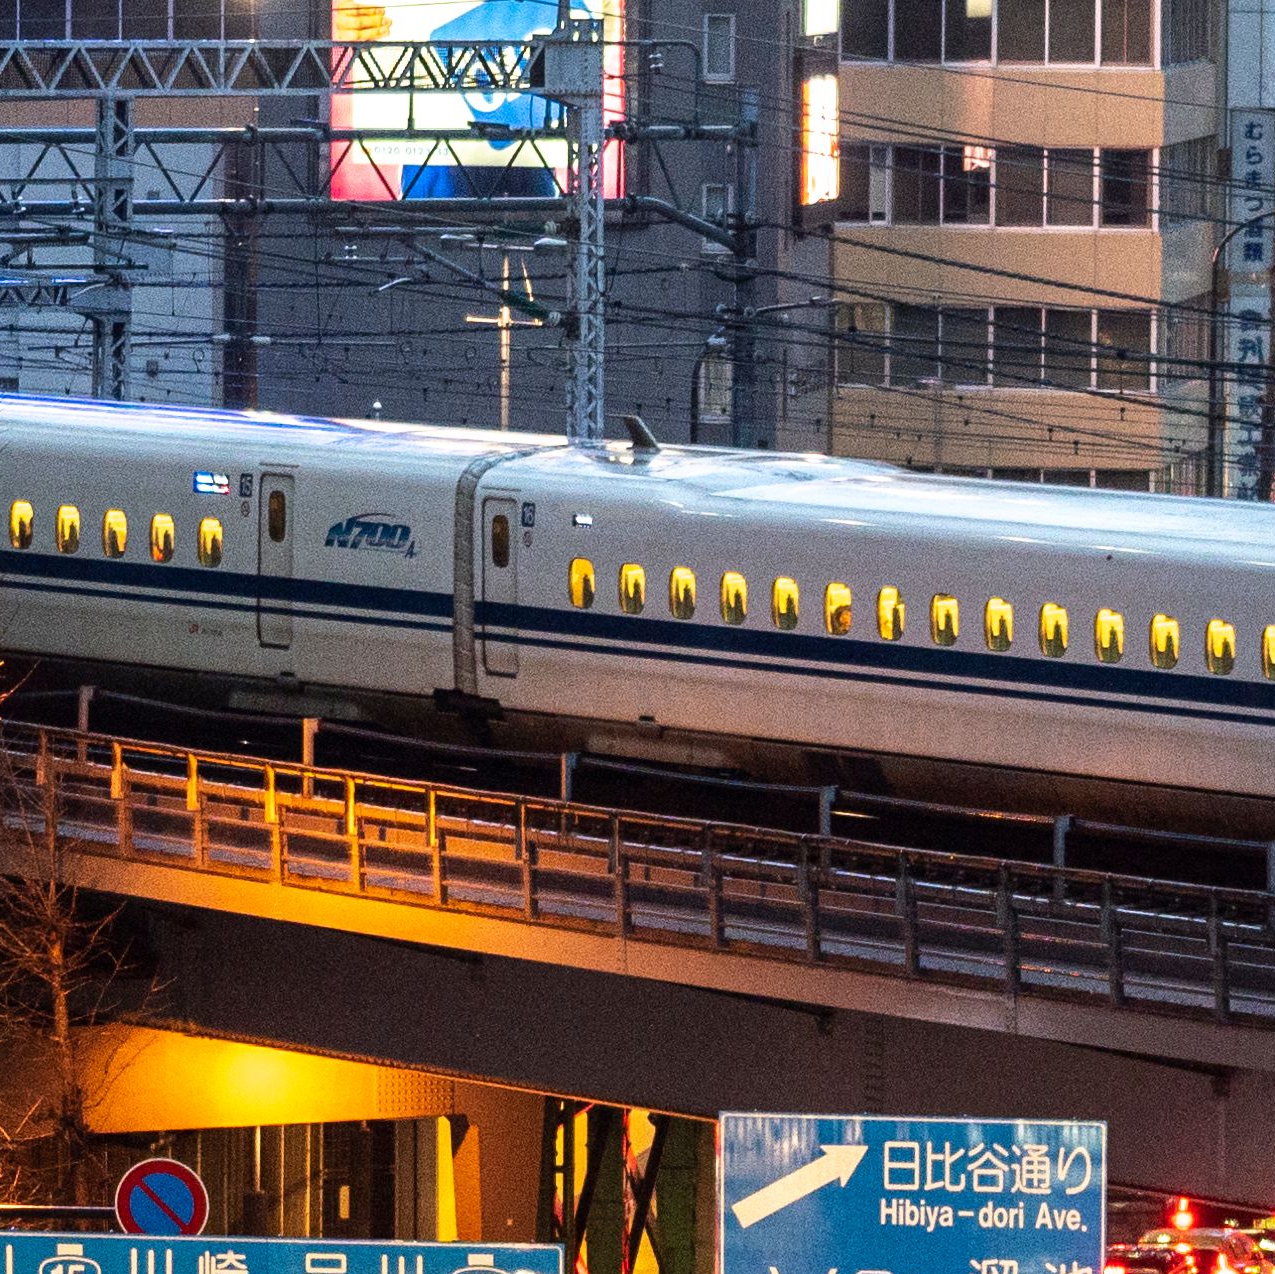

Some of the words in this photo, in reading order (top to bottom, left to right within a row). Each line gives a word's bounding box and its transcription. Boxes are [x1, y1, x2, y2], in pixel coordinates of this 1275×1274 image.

[882, 1140, 1093, 1196] 日比谷通り
[880, 1198, 1025, 1233] Hibiya-dori
[1035, 1203, 1088, 1232] Ave.
